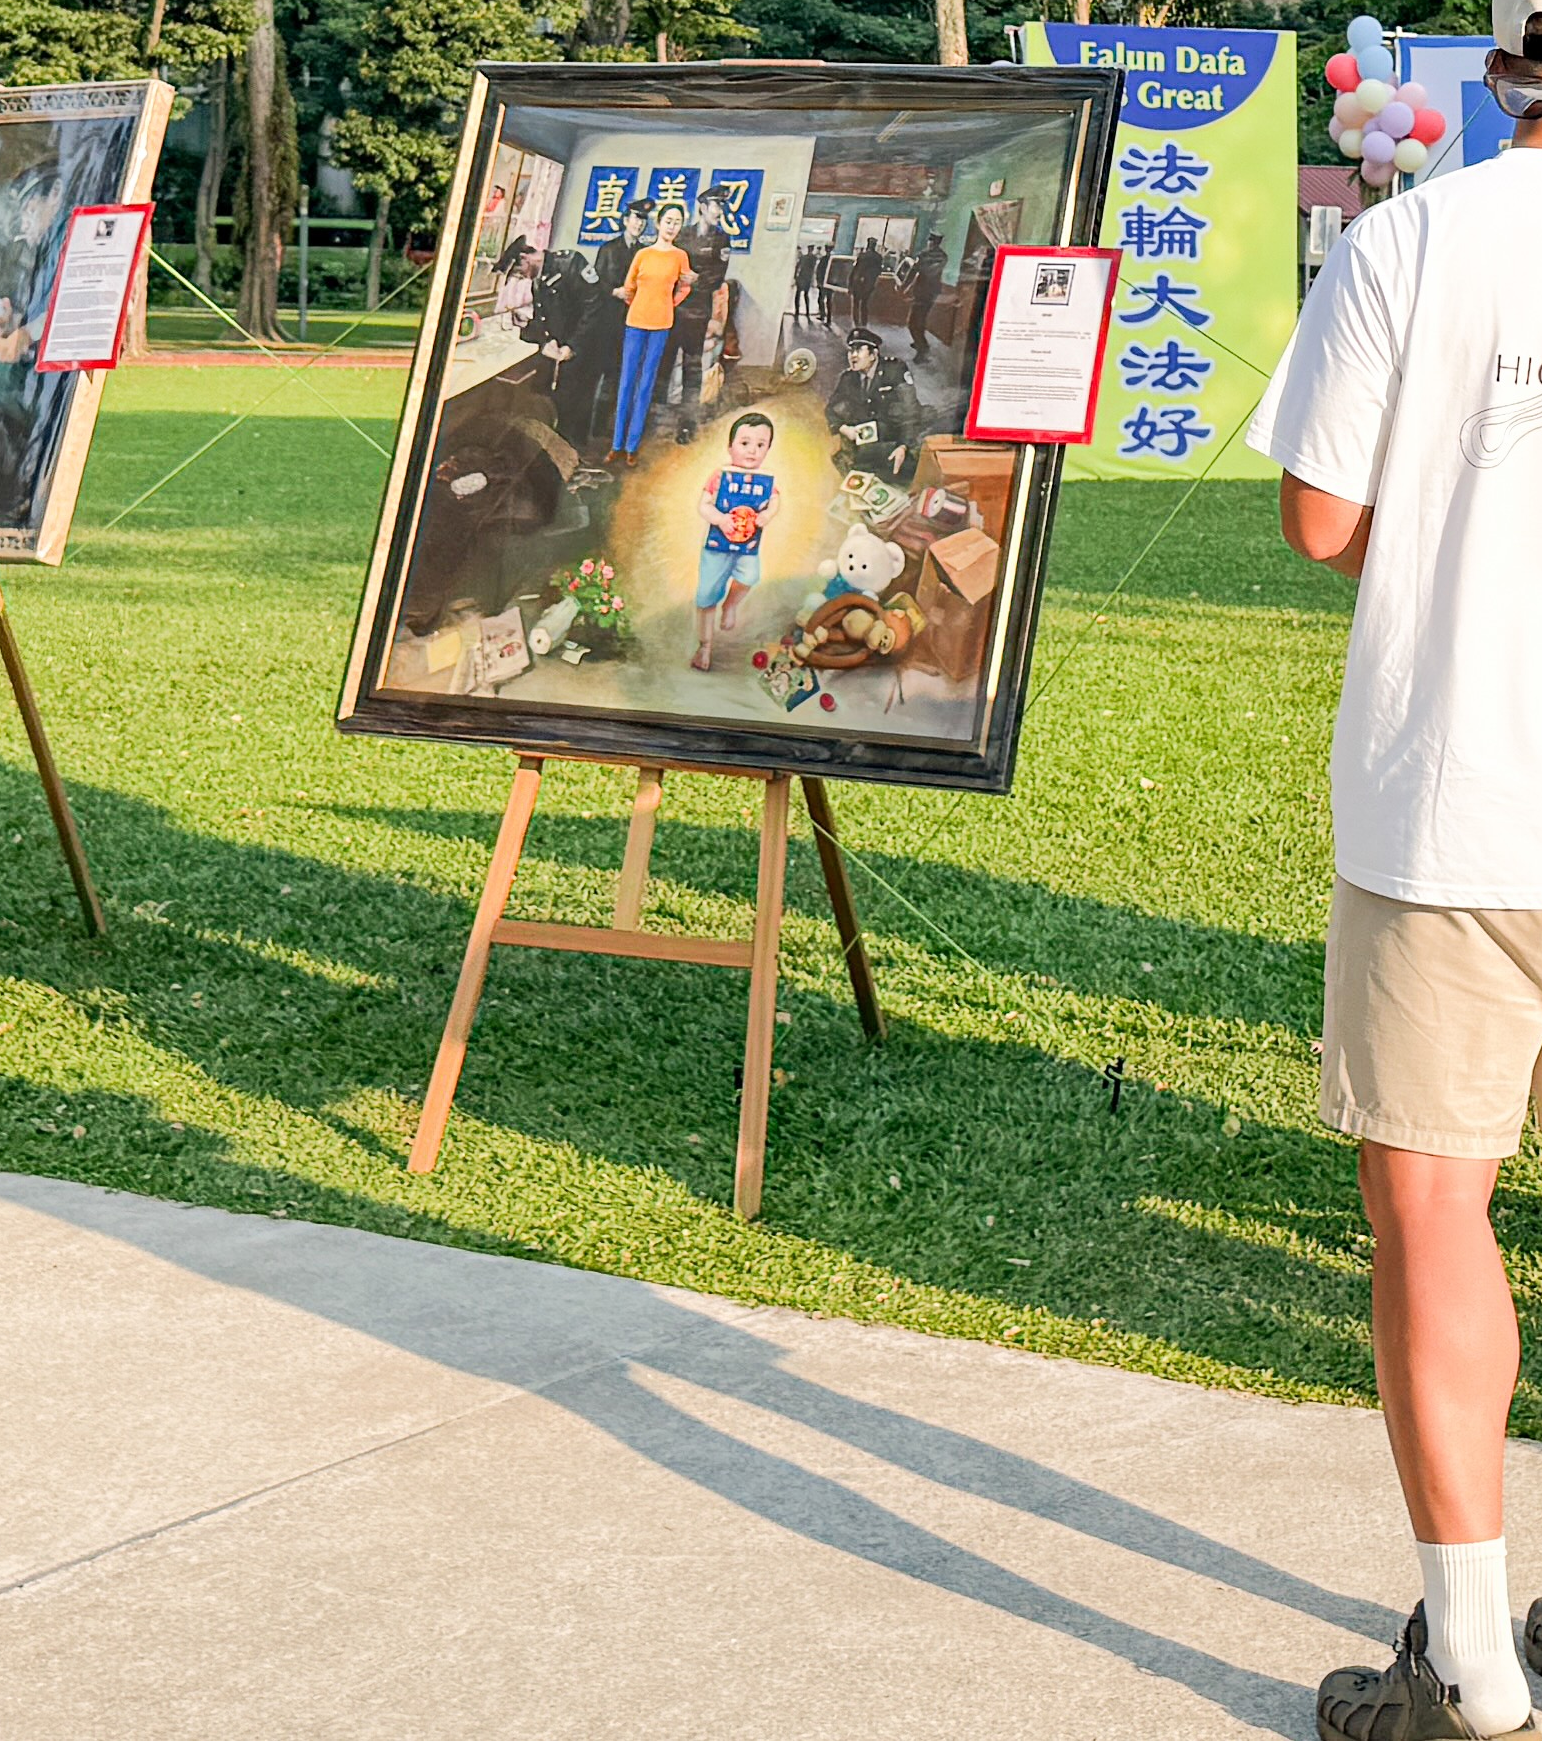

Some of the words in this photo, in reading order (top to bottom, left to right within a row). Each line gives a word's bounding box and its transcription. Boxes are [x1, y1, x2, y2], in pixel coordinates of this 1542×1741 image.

[1080, 41, 1165, 72] Falun
[1176, 46, 1247, 76] Dafa
[1137, 81, 1224, 111] Great
[1119, 144, 1211, 458] 法輪大法好
